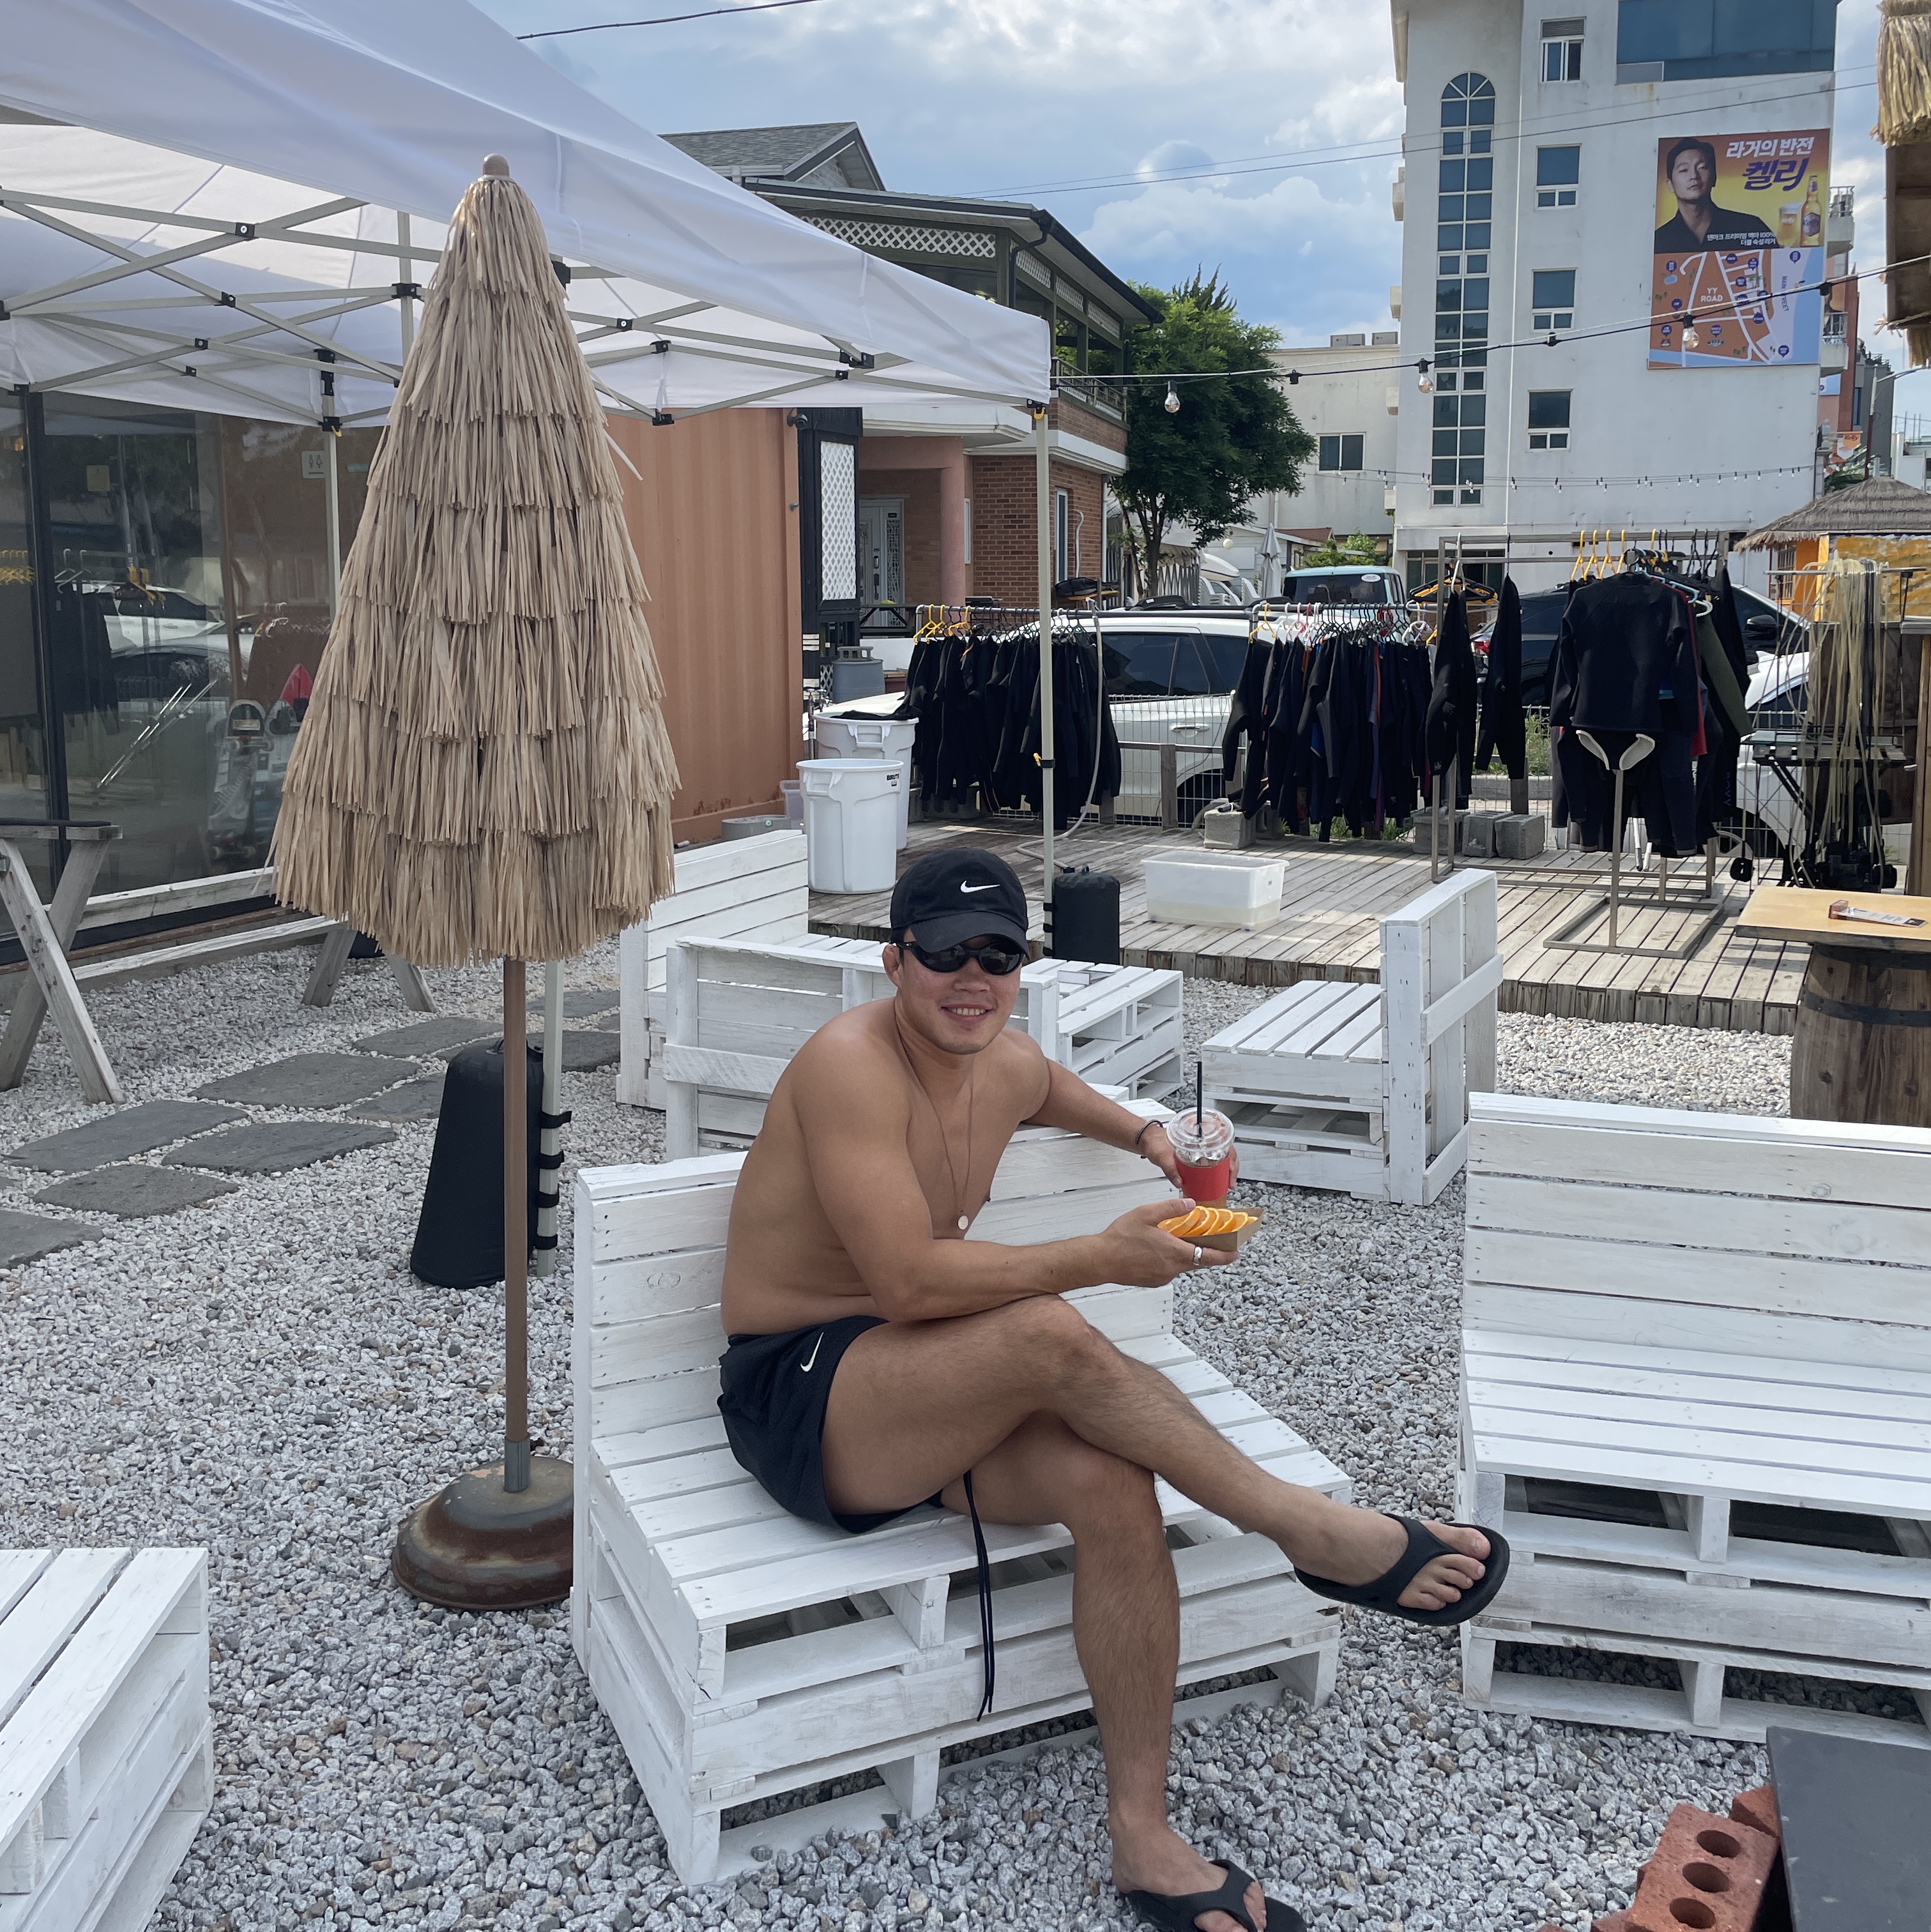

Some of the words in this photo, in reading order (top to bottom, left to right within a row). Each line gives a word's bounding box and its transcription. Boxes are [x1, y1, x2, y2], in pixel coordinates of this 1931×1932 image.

[1726, 139, 1778, 158] 라거의
[1779, 136, 1815, 156] 반전
[1742, 157, 1810, 192] 켈리
